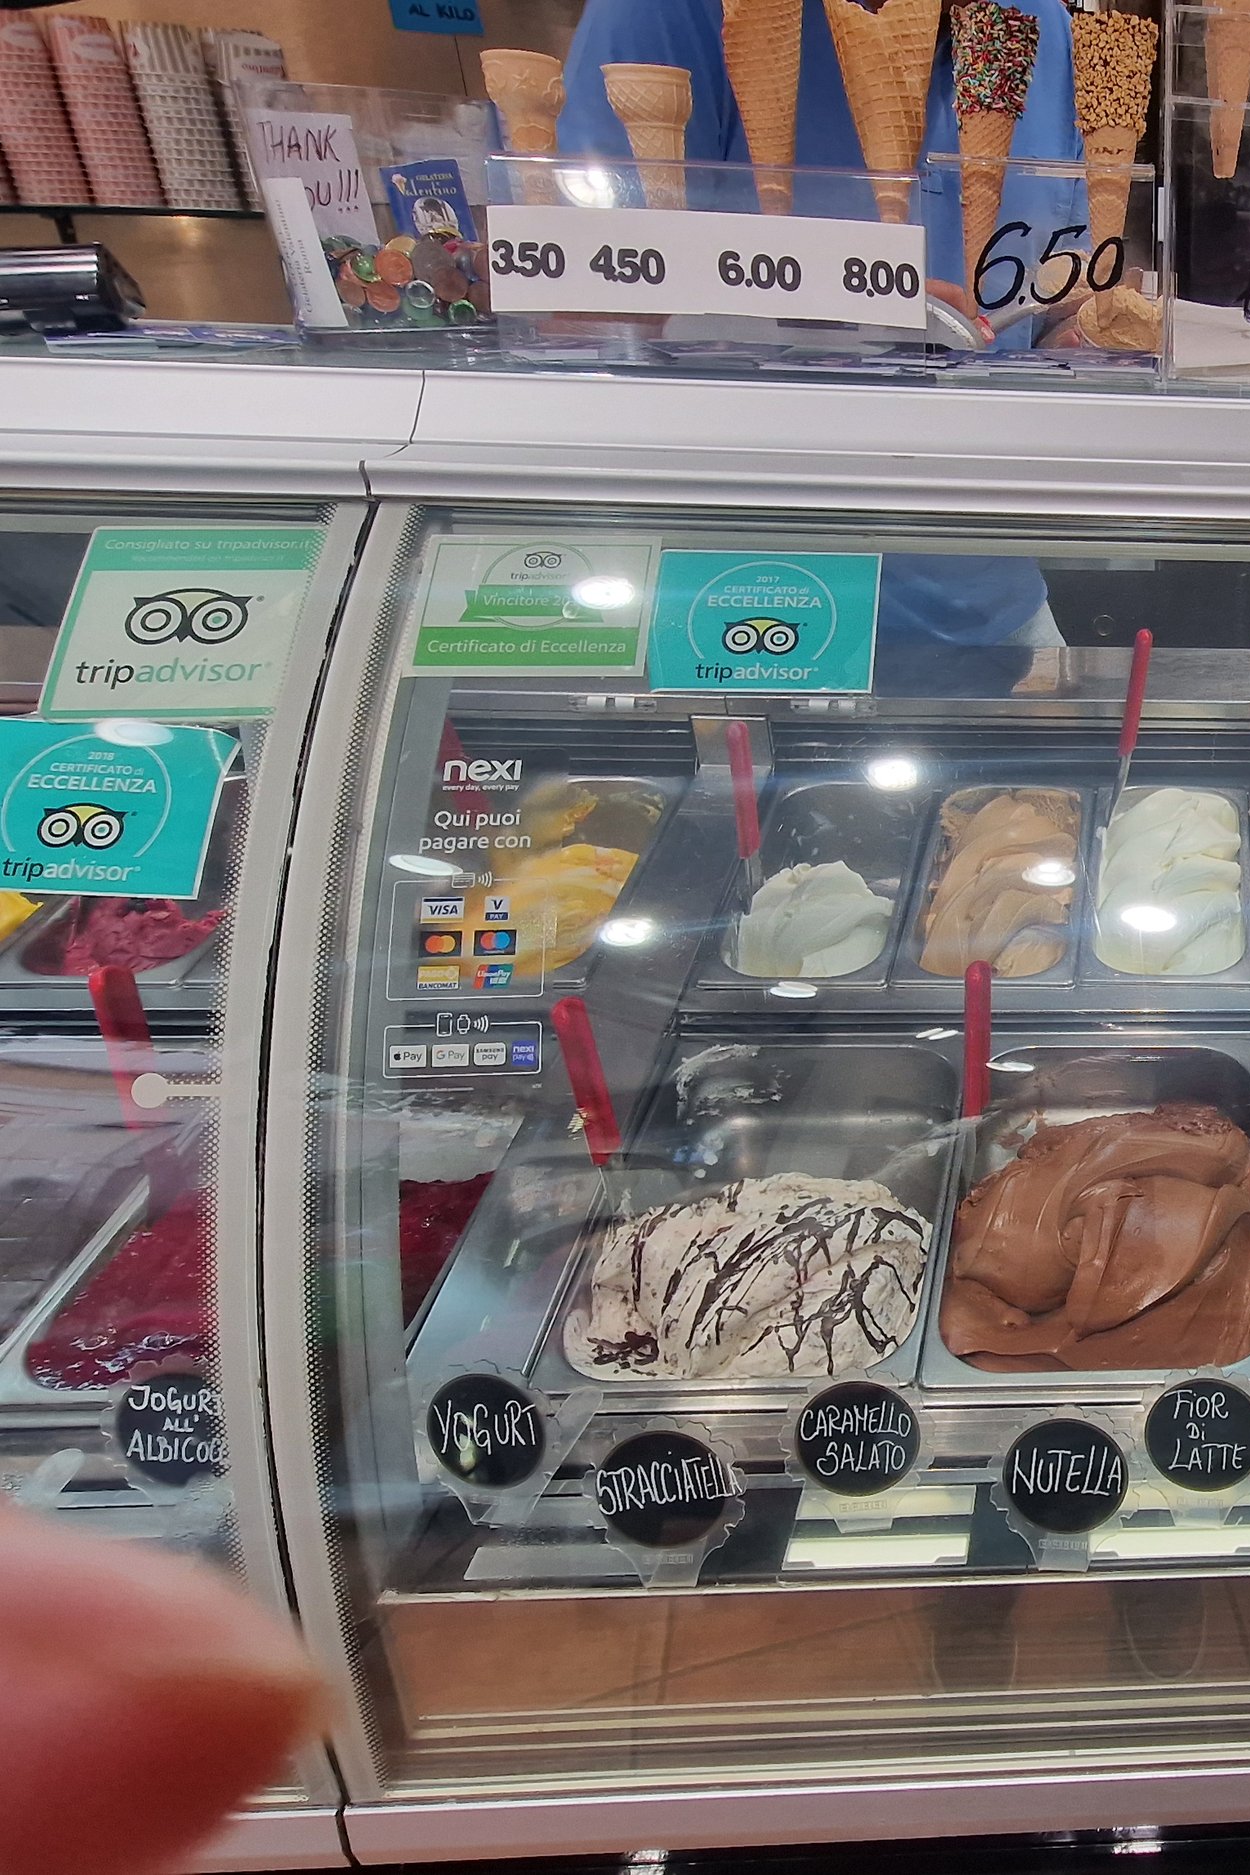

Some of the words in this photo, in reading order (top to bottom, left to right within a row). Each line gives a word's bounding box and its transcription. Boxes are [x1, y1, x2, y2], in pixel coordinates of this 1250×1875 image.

[408, 3, 431, 17] AL
[435, 3, 475, 21] KILO
[258, 120, 341, 163] THANK
[304, 168, 360, 214] OU!!!
[491, 239, 566, 280] 3.50
[589, 244, 667, 286] 4.50
[717, 250, 802, 292] 6.00
[842, 256, 920, 299] 8.00
[973, 220, 1124, 310] 6.50
[104, 538, 191, 552] Consigliato
[194, 540, 212, 550] su
[756, 576, 780, 584] 2017
[724, 585, 798, 595] CERTIFICATO
[799, 587, 810, 595] di
[483, 594, 550, 607] Vincitore
[707, 595, 822, 608] ECCELLENZA
[427, 639, 516, 654] Certificato
[519, 639, 536, 654] di
[540, 639, 627, 654] Eccellenza
[75, 657, 265, 690] tripadvisor
[695, 662, 813, 683] tripadvisor
[87, 751, 116, 761] 2018
[50, 762, 134, 776] CERTIFICATO
[442, 759, 523, 783] nexi
[27, 774, 157, 794] ECCELLENZA
[465, 784, 481, 792] day,
[434, 809, 471, 830] Qui
[475, 808, 522, 831] puoi
[418, 836, 489, 854] pagare
[494, 835, 531, 849] con
[2, 856, 136, 882] tripadvisor
[428, 904, 459, 916] VISA
[491, 899, 504, 911] V
[418, 982, 458, 990] BANCOMAT
[403, 1051, 423, 1062] Pay
[447, 1050, 466, 1061] Pay
[481, 1053, 499, 1061] pay
[512, 1045, 535, 1054] nexi
[512, 1054, 528, 1062] pay
[432, 1399, 537, 1456] YOGURT
[799, 1399, 912, 1442] CARAMELLO
[816, 1439, 907, 1476] SALATO
[1167, 1438, 1248, 1473] LATTE
[1011, 1445, 1123, 1497] NUTELLA
[595, 1452, 744, 1516] STRACCIATELLA
